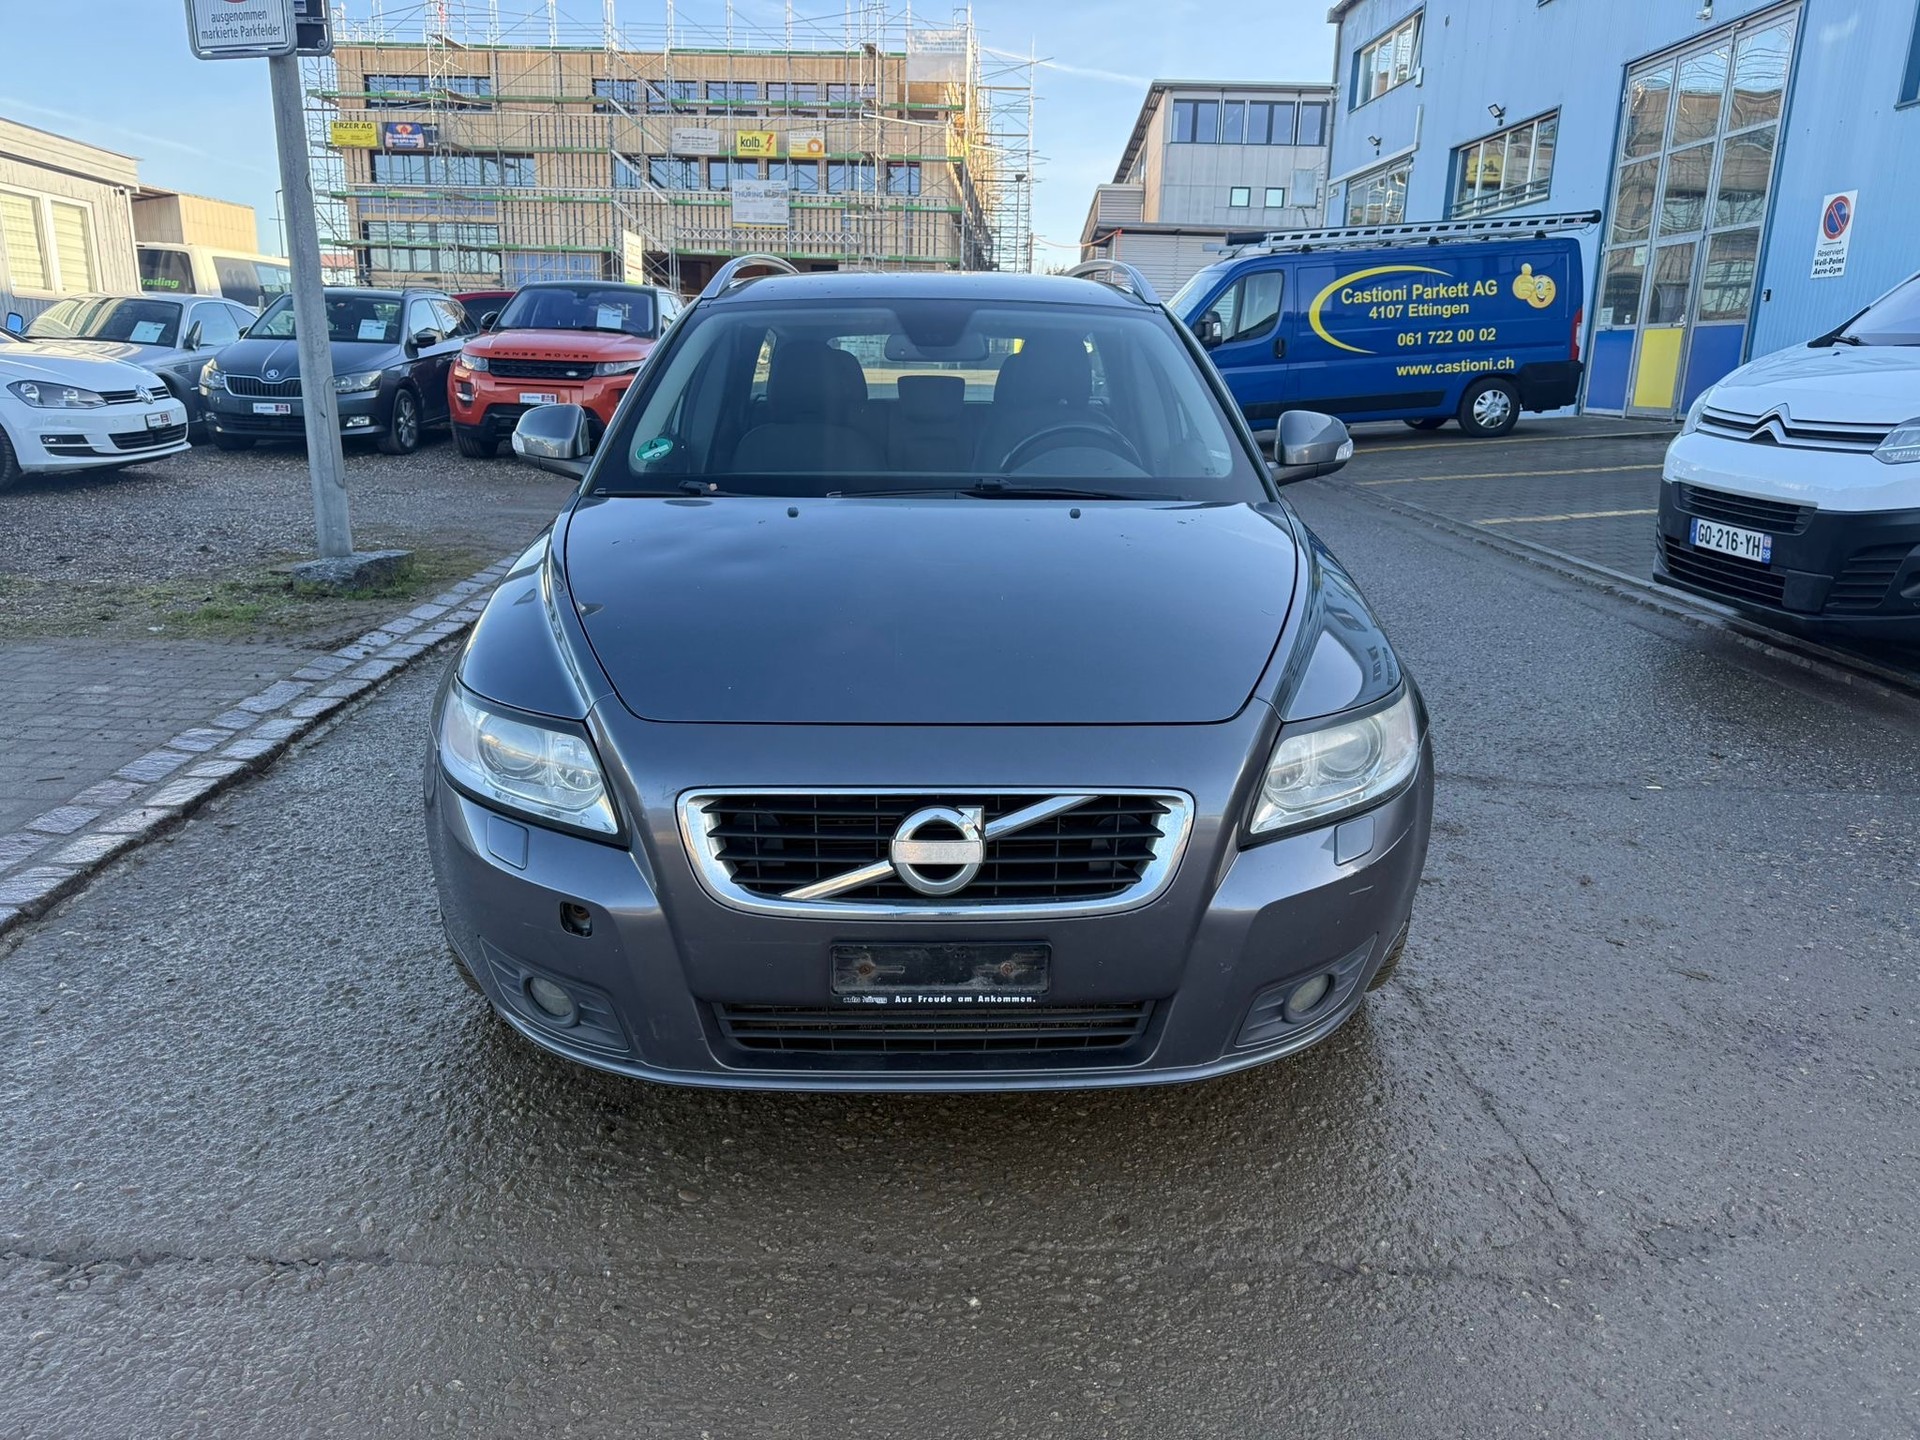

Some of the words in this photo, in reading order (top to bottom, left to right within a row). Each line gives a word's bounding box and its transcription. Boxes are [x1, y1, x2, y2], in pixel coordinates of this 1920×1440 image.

[211, 10, 267, 25] ausgenommen
[201, 25, 238, 39] markierte
[240, 23, 281, 37] Parkfelder
[740, 135, 760, 148] kolb
[1817, 248, 1845, 258] Reserviert
[1814, 256, 1845, 267] Well-Point
[1812, 266, 1843, 276] Aero-Gym
[1341, 284, 1407, 305] Castioni
[1412, 281, 1469, 301] Parkett
[1472, 279, 1498, 297] AG
[1369, 304, 1404, 320] 4107
[1408, 302, 1470, 319] Ettingen
[1397, 331, 1422, 347] 061
[1428, 329, 1454, 345] 722
[1457, 328, 1475, 343] 00
[1479, 327, 1496, 342] 02
[1396, 356, 1515, 377] www.castioni.ch
[1698, 523, 1761, 558] GQ-216-YH
[894, 995, 912, 1003] Aus
[918, 994, 953, 1003] Freude
[977, 994, 1036, 1003] Ankommen.
